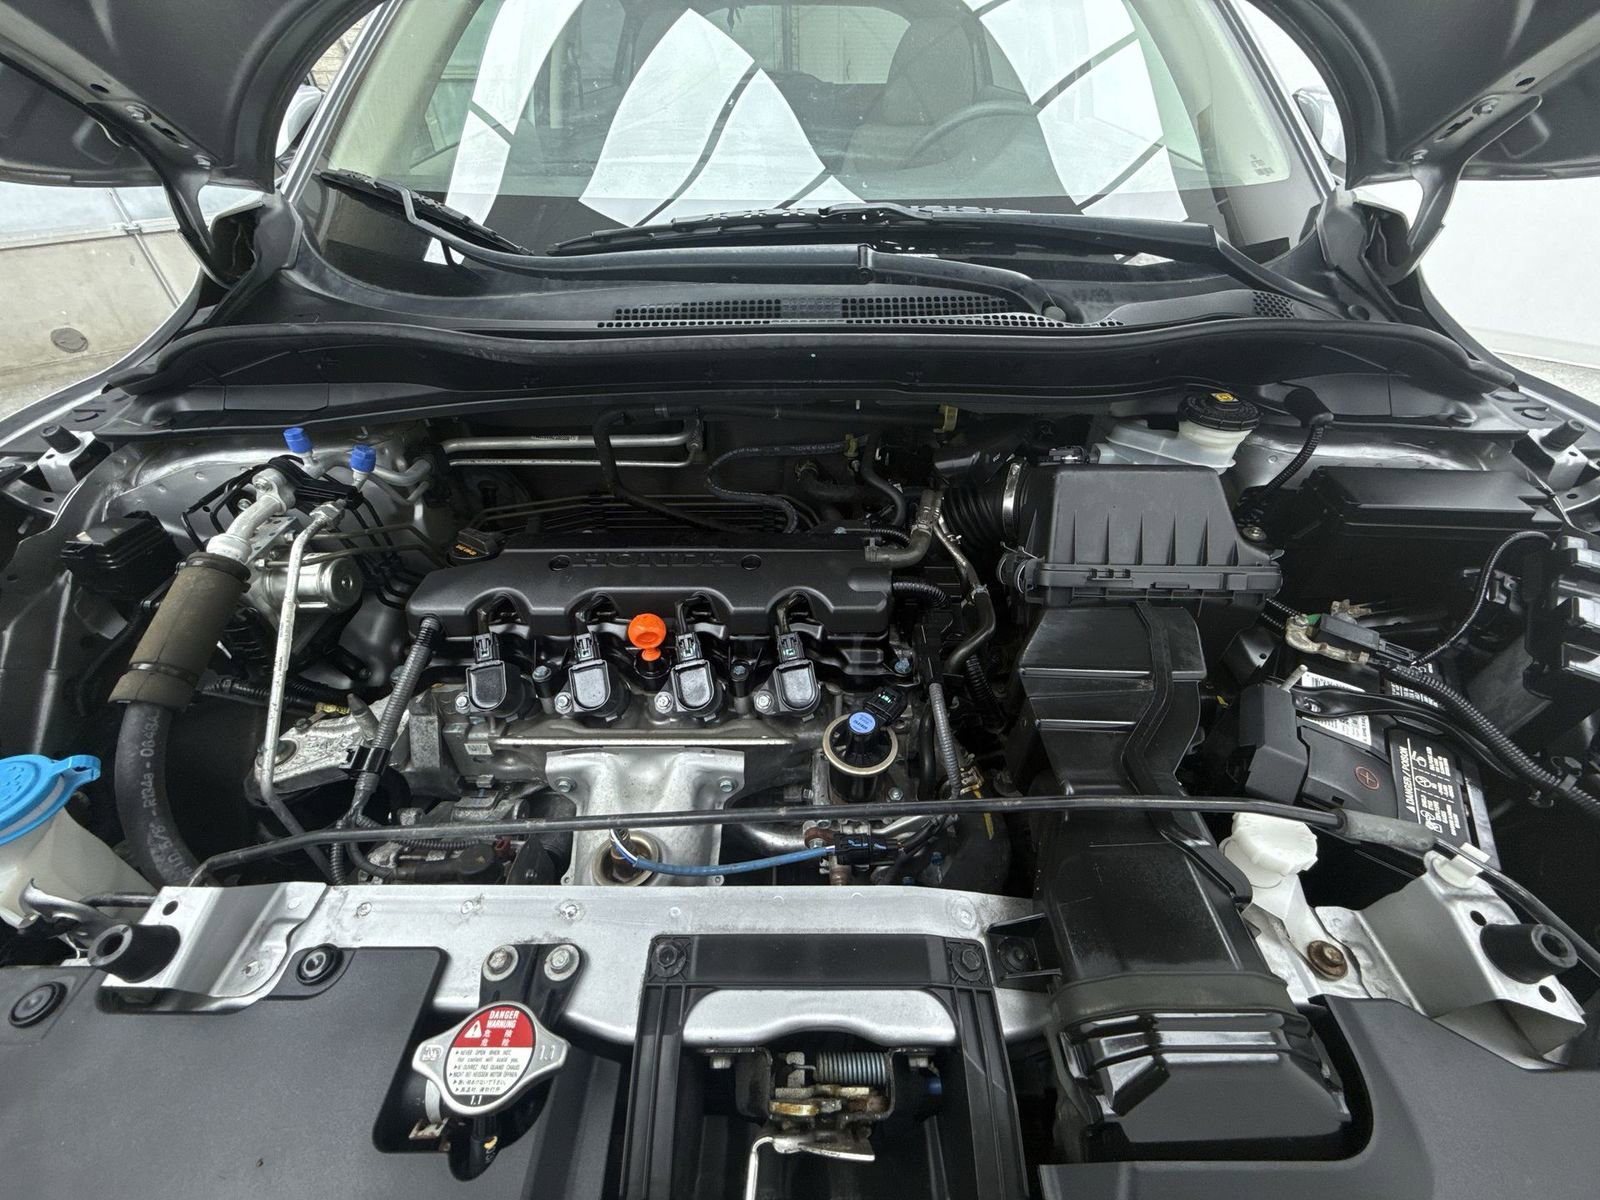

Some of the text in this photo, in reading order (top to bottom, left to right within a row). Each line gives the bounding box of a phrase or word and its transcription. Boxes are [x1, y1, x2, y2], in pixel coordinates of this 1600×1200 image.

[572, 553, 737, 567] HONDA
[1399, 746, 1410, 772] POISON
[1403, 776, 1415, 806] DANGER
[489, 1010, 520, 1019] DANGER
[486, 1019, 517, 1029] WARNUNG
[471, 1095, 483, 1105] 1.1
